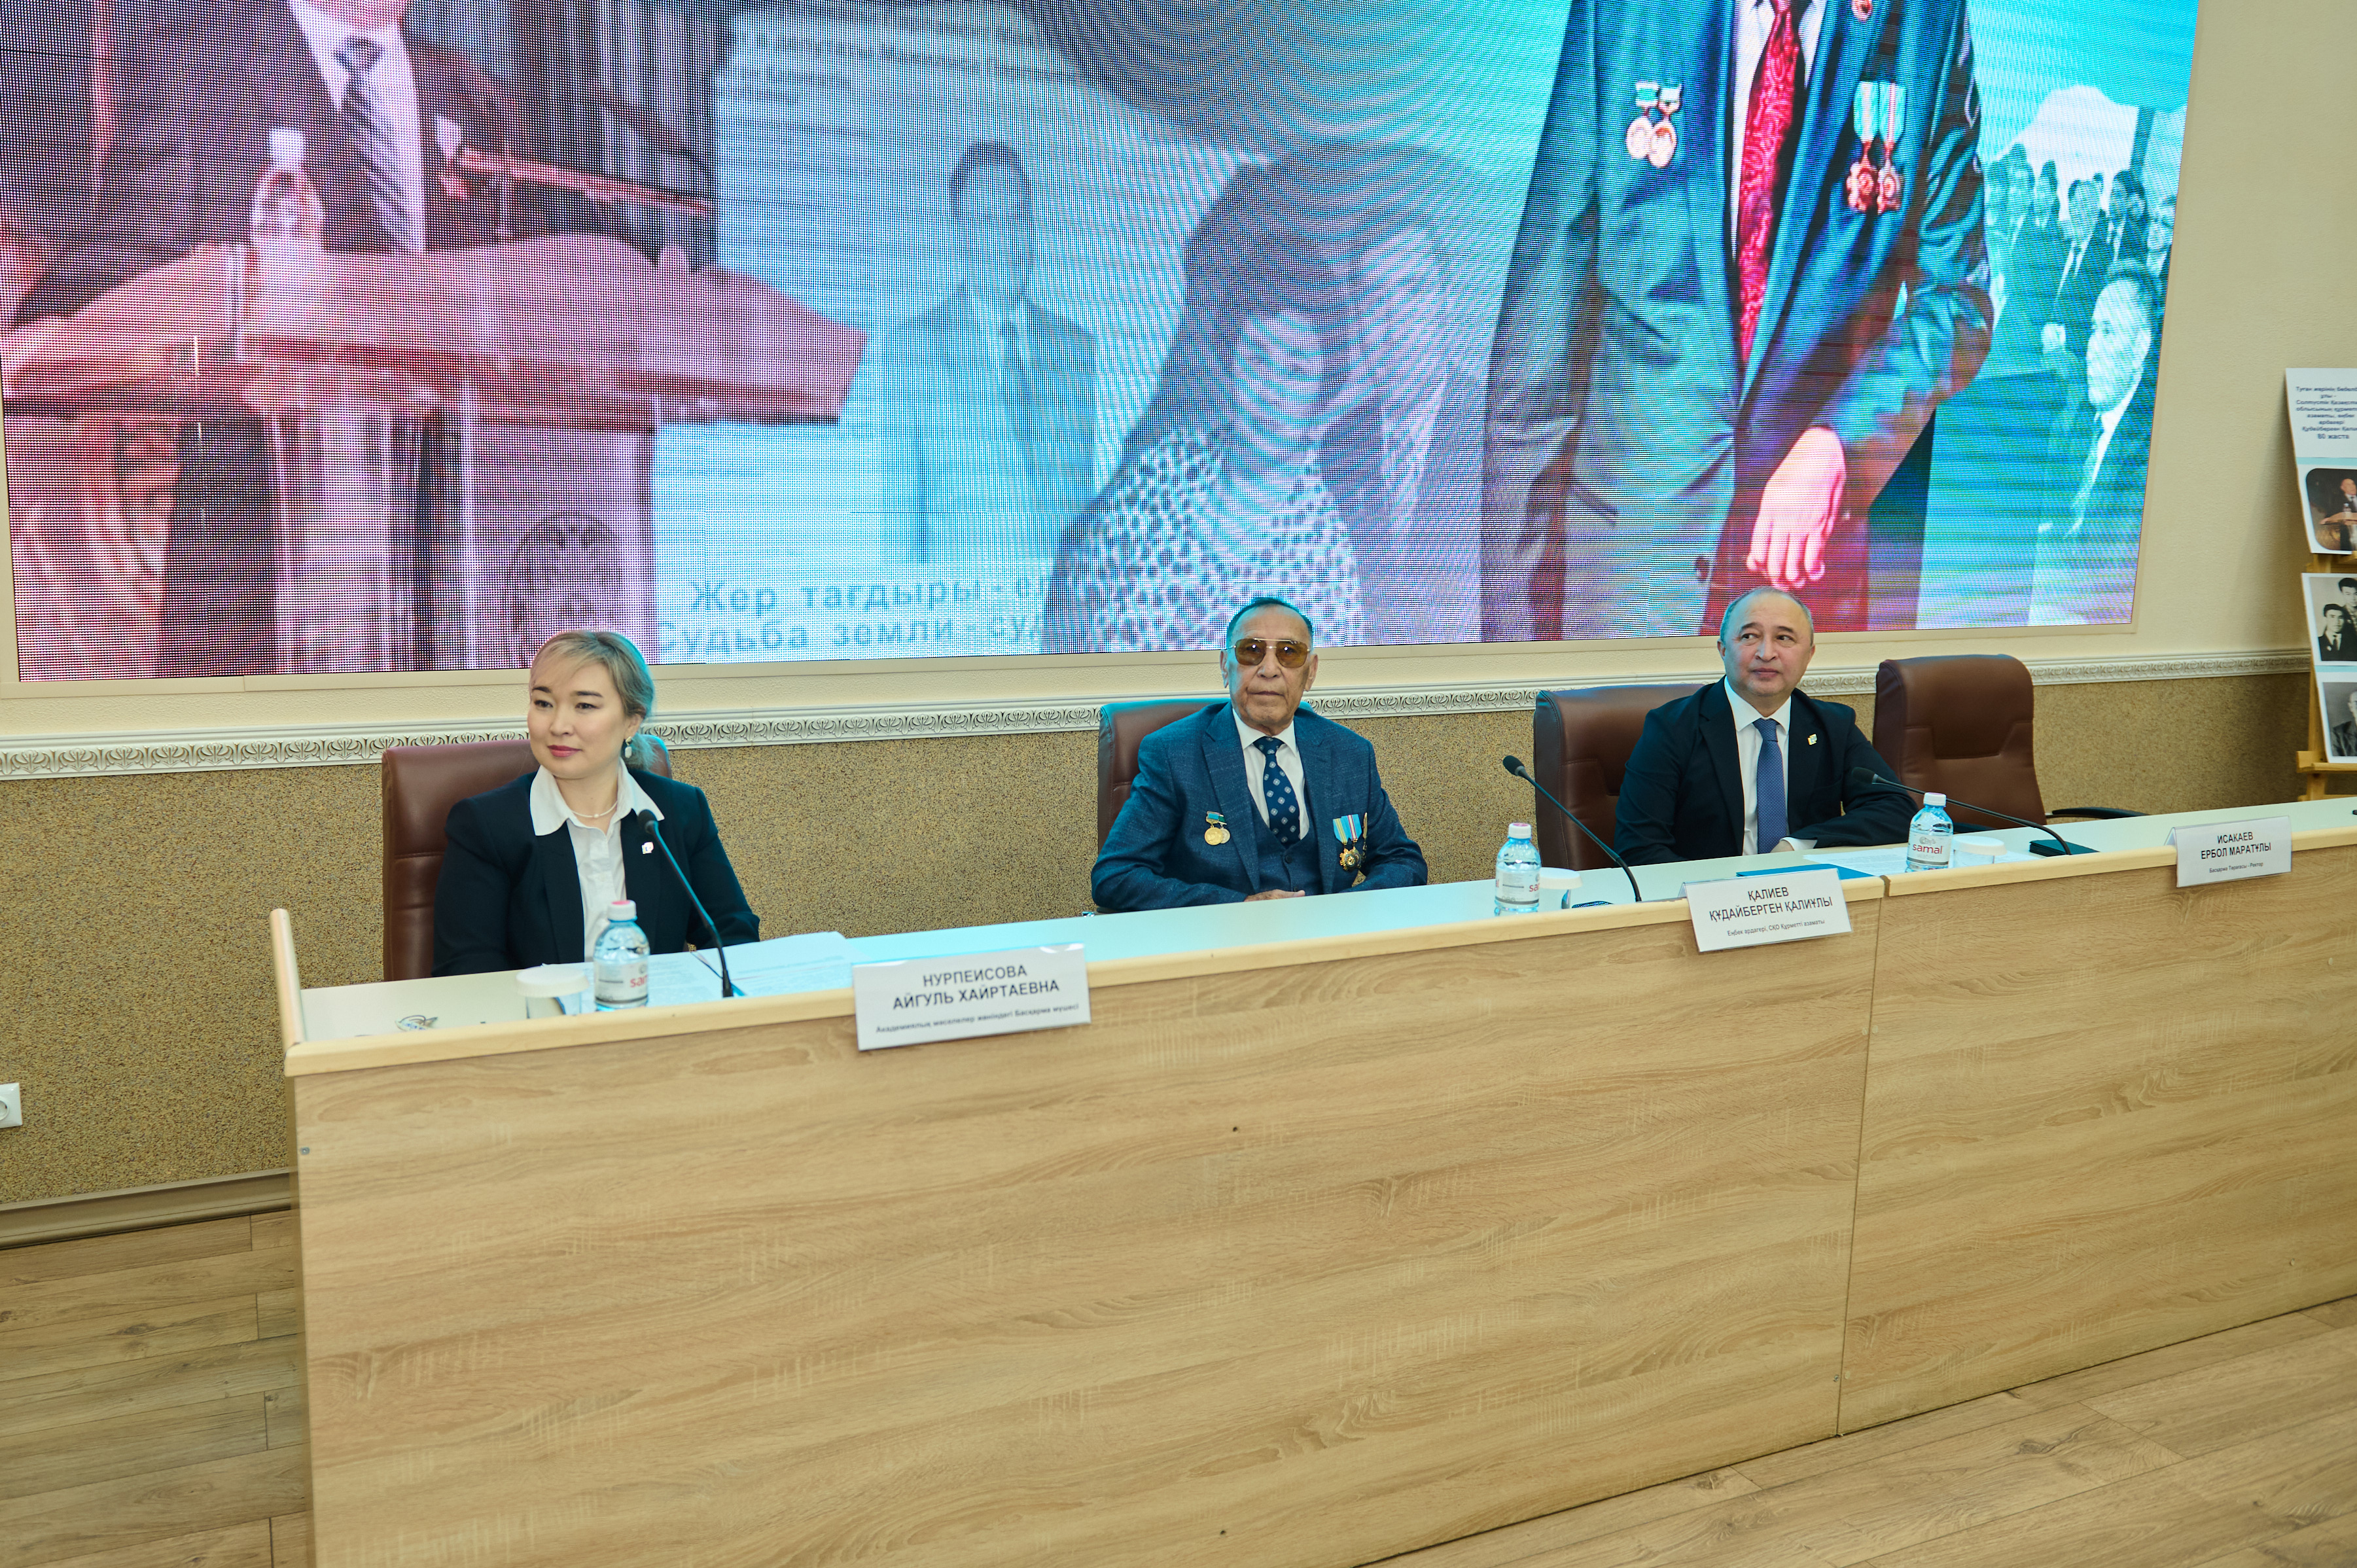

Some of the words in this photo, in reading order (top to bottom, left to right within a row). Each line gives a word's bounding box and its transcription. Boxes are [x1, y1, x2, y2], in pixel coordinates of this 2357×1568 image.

[690, 579, 777, 618] Жер
[657, 620, 809, 656] Судьба
[832, 618, 953, 648] земли
[1912, 844, 1943, 854] samal
[2217, 832, 2254, 844] ИСАКАЕВ
[2201, 847, 2227, 859] ЕРБОЛ
[2229, 842, 2271, 856] МАРАТҰЛЫ
[1748, 887, 1789, 902] ҚАЛИЕВ
[1709, 902, 1782, 922] ҚҰДАЙБЕРГЕН
[1785, 897, 1834, 913] ҚАЛИҰЛЫ
[923, 965, 1028, 988] НУРПЕИСОВА
[893, 990, 954, 1010] АЙГУЛЬ
[958, 980, 1059, 1003] ХАЙРТАЕВНА
